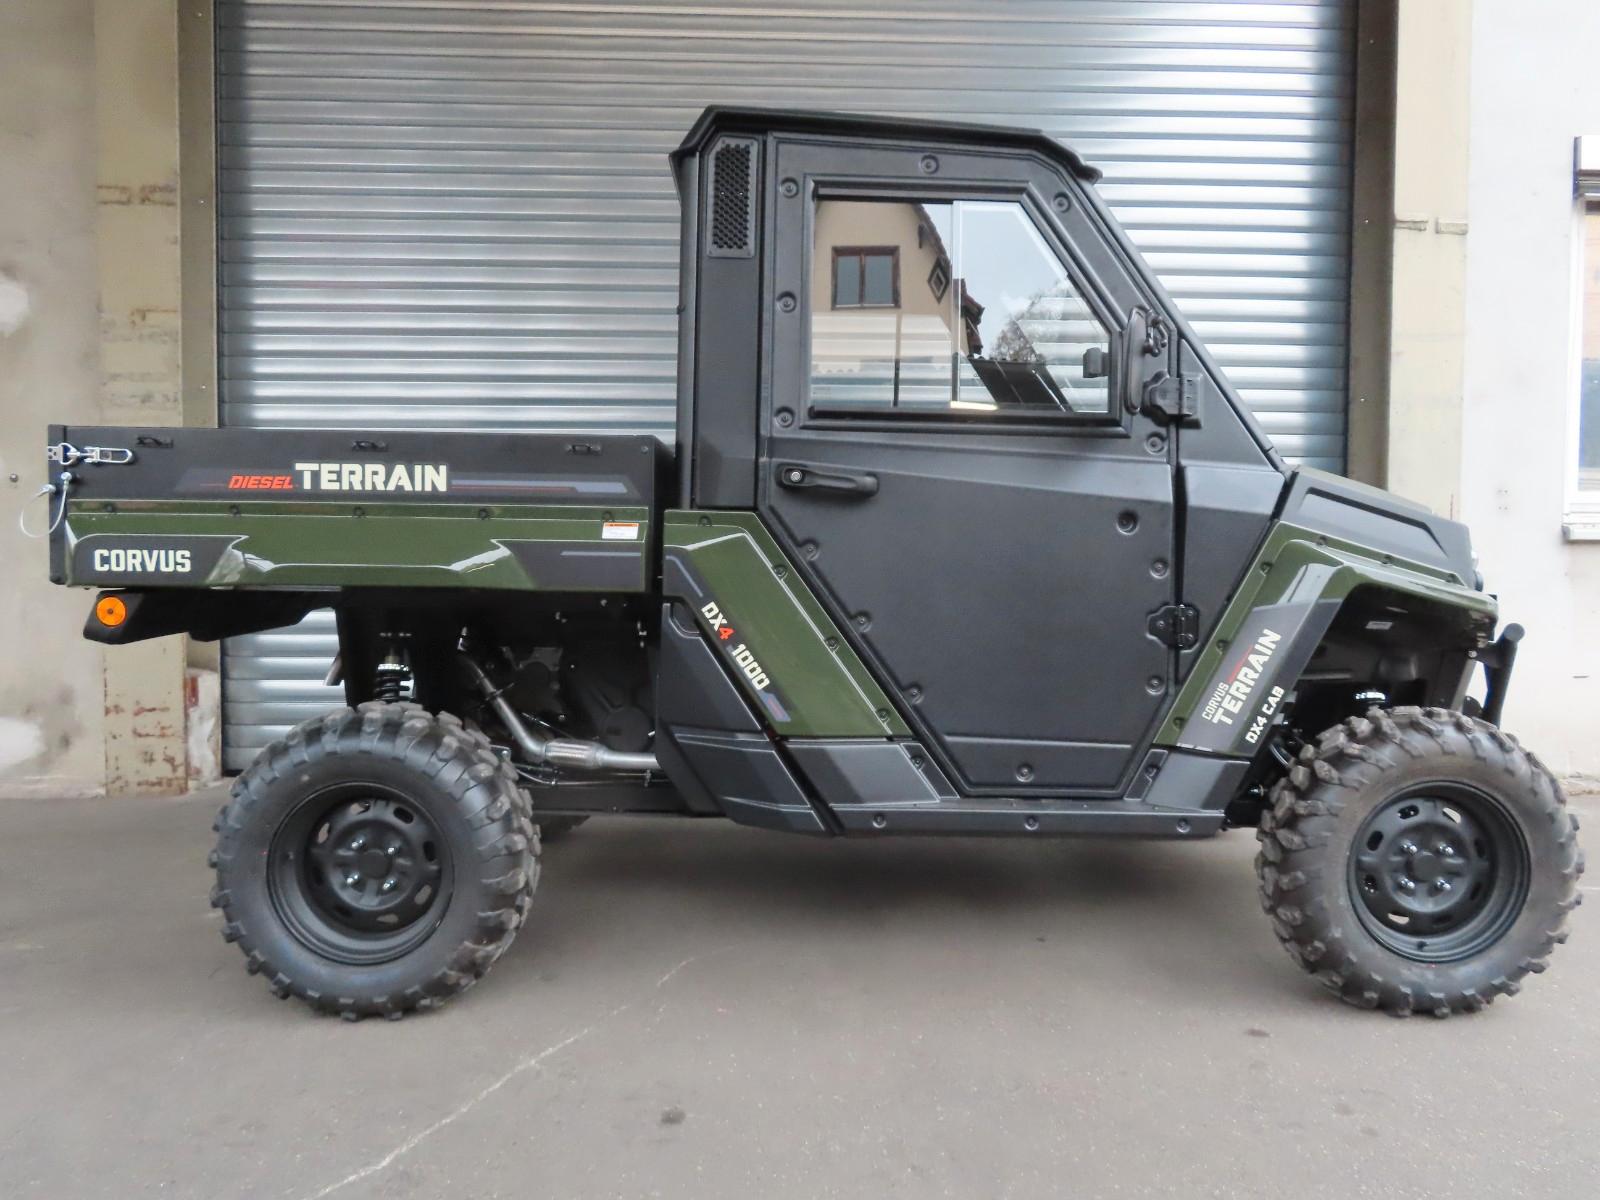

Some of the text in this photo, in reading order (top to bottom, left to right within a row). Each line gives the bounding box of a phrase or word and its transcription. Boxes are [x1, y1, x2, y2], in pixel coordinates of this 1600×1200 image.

[229, 463, 448, 492] DIESEL TERRAIN
[94, 549, 192, 572] CORVUS
[701, 601, 771, 690] DX4 1000
[1212, 628, 1282, 725] TERRAIN
[1202, 682, 1229, 720] CORVUS
[1245, 685, 1285, 744] DX4 CAB
